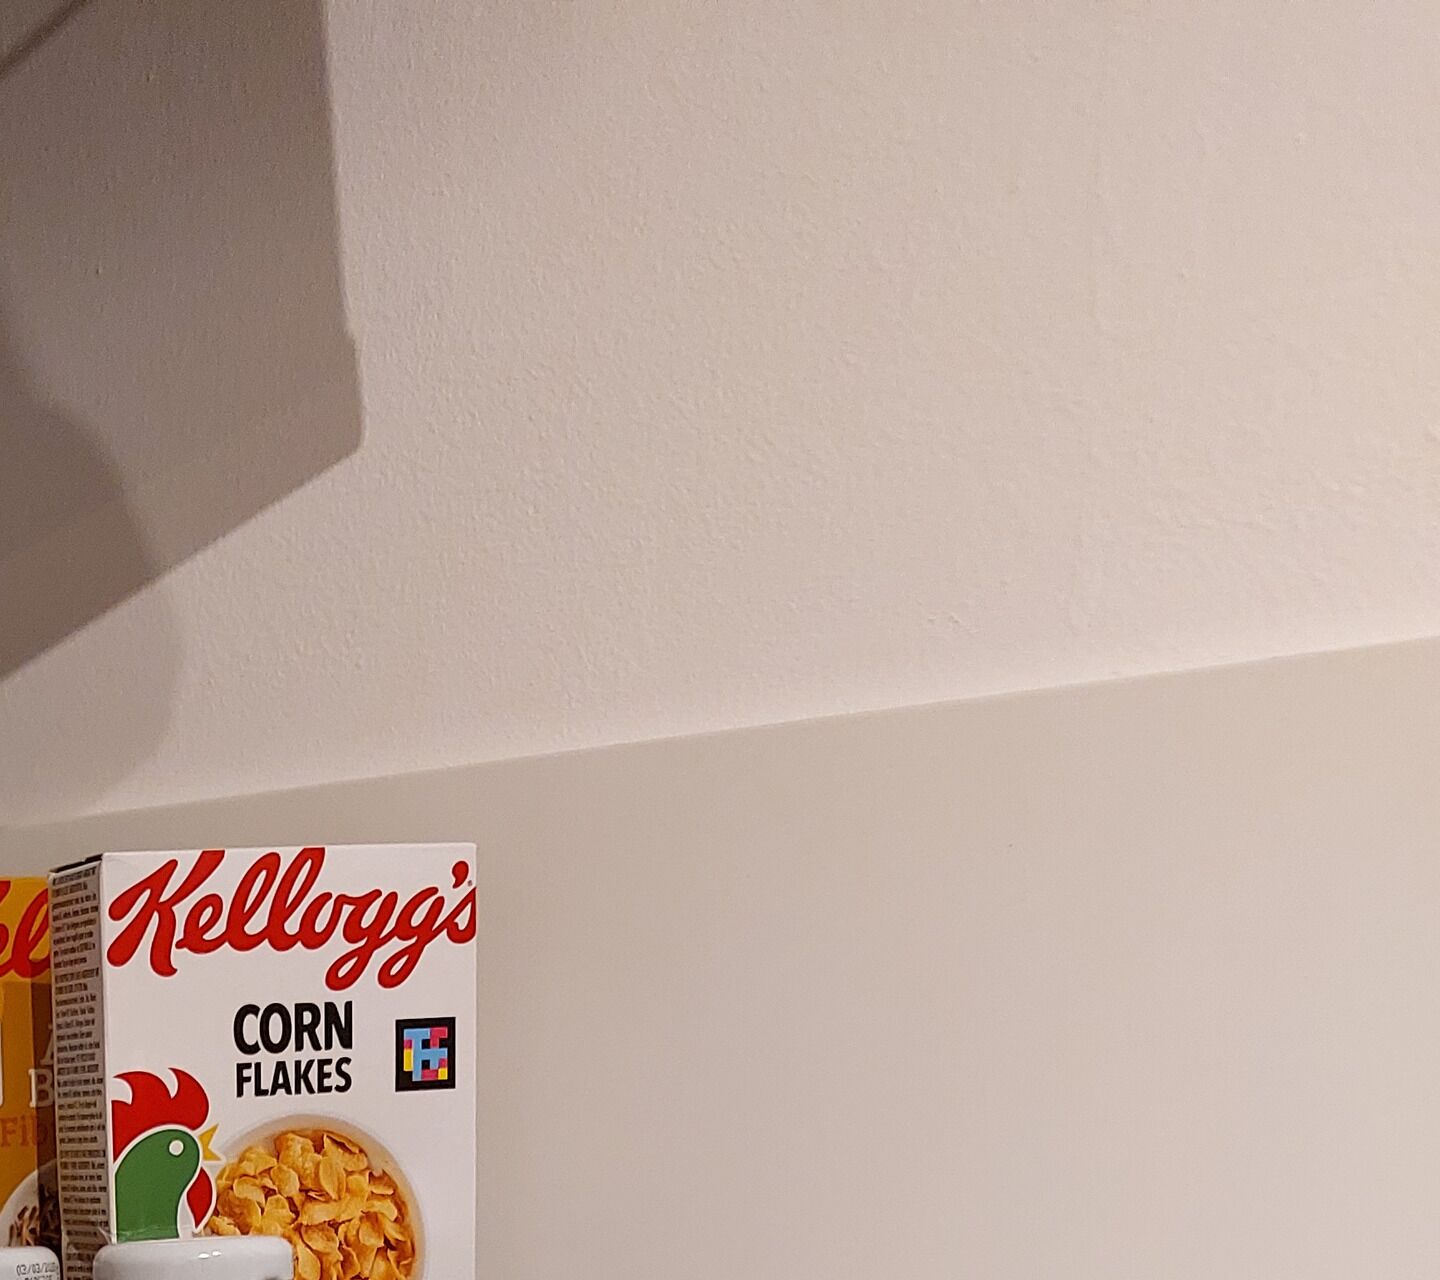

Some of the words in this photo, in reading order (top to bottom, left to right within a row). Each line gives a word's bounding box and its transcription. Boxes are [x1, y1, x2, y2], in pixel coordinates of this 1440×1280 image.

[107, 847, 477, 991] Kellogg's
[233, 1000, 353, 1055] CORN
[236, 1057, 353, 1098] FLAKES
